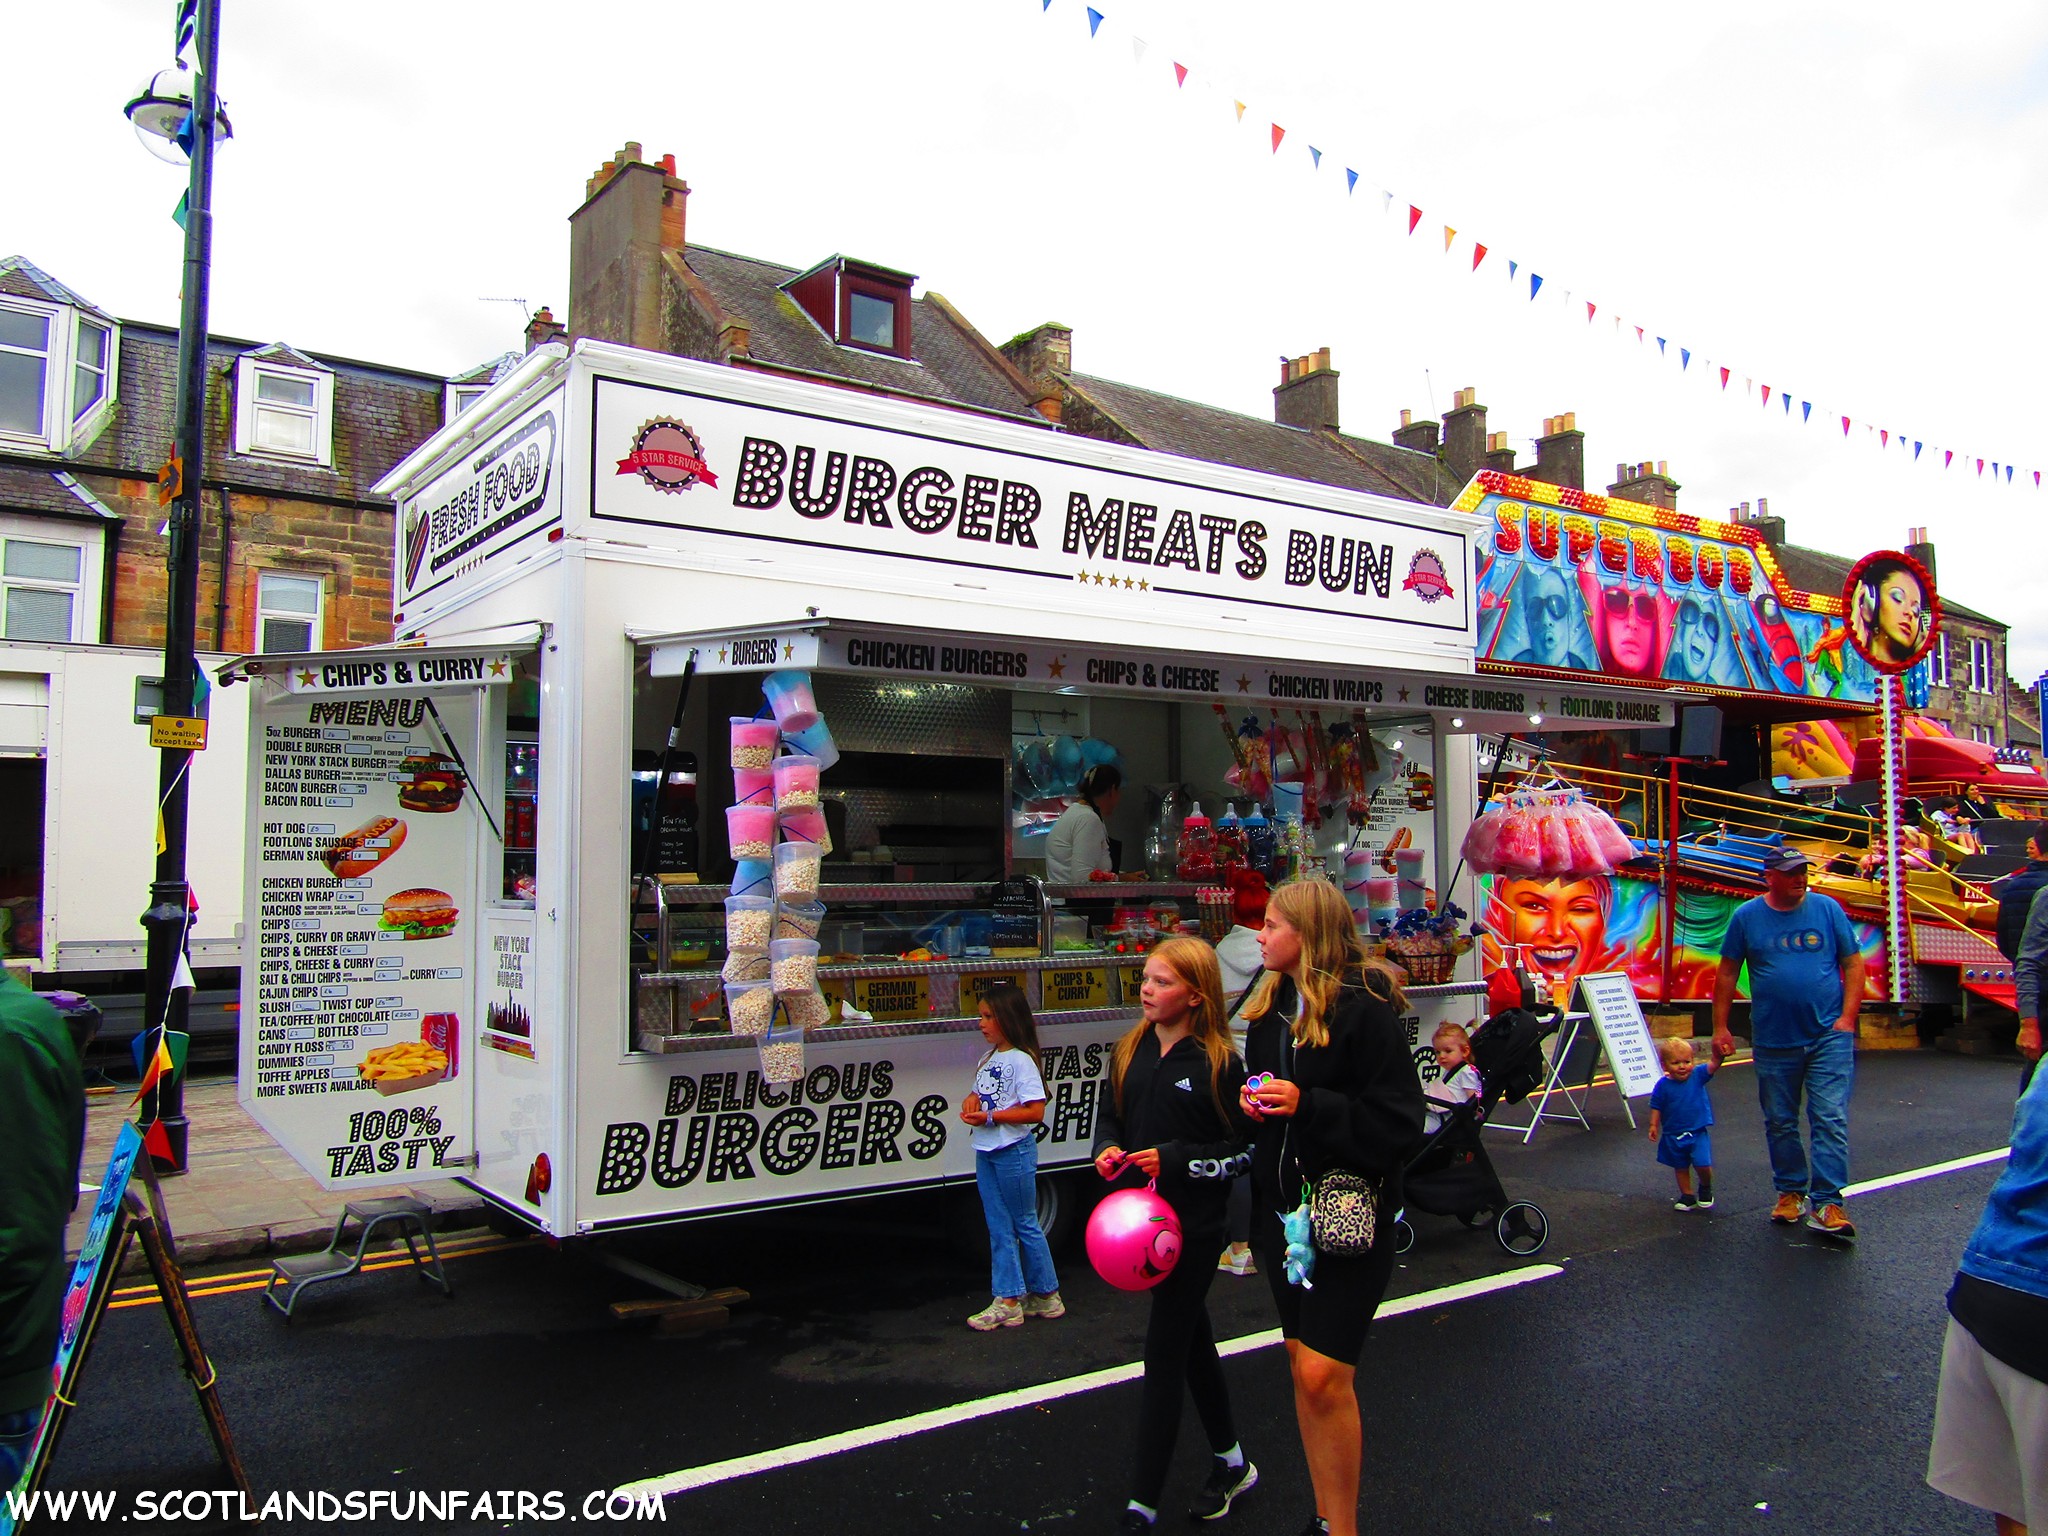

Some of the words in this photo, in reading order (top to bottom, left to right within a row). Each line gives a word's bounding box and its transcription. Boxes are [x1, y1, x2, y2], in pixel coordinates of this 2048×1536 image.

[632, 453, 639, 464] 5
[641, 452, 665, 463] STAR
[667, 454, 704, 473] SERVICE
[430, 480, 480, 553] FRESH
[483, 442, 540, 520] FOOD
[732, 435, 1042, 549] BURGER
[1062, 491, 1268, 581] MEATS
[1284, 528, 1394, 599] BUN
[731, 638, 777, 666] BURGERS
[847, 638, 934, 672] CHICKEN
[940, 645, 1028, 678] BURGERS
[323, 662, 388, 688] CHIPS
[393, 660, 413, 684] &
[418, 657, 486, 683] CURRY
[1087, 658, 1138, 686] CHIPS
[1141, 662, 1157, 688] &
[1161, 664, 1220, 693] CHEESE
[1268, 673, 1330, 699] CHICKEN
[1333, 678, 1383, 703] WRAPS
[1424, 684, 1469, 709] CHEESE
[1471, 688, 1525, 713] BURGERS
[309, 699, 428, 728] MENU
[1560, 696, 1614, 719] FOOTLONG
[1616, 700, 1661, 723] SAUSAGE
[172, 730, 201, 739] waiting
[266, 726, 281, 737] 5oz
[283, 726, 321, 739] BURGER
[154, 739, 182, 747] except
[266, 740, 302, 753] DOUBLE
[305, 742, 342, 754] BURGER
[265, 754, 288, 766] NEW
[291, 755, 316, 767] YORK
[319, 756, 349, 768] STACK
[351, 757, 388, 769] BURGER
[265, 767, 302, 779] DALLAS
[304, 769, 341, 781] BURGER
[265, 781, 298, 793] BACON
[300, 782, 338, 794] BURGER
[264, 795, 298, 806] BACON
[300, 796, 323, 807] ROLL
[264, 823, 283, 834] HOT
[286, 823, 306, 834] DOG
[263, 837, 312, 848] FOOTLONG
[315, 837, 358, 848] SAUSAGE
[263, 850, 304, 861] GERMAN
[262, 878, 303, 889] CHICKEN
[306, 878, 343, 888] BURGER
[262, 891, 303, 902] CHICKEN
[306, 892, 334, 902] WRAP
[261, 904, 302, 916] NACHOS
[261, 919, 290, 930] CHIPS
[261, 932, 293, 944] CHIPS,
[296, 932, 327, 943] CURRY
[330, 932, 344, 942] OR
[346, 931, 376, 942] GRAVY
[494, 936, 510, 952] NEW
[511, 936, 530, 953] YORK
[261, 946, 291, 957] CHIPS
[292, 946, 300, 956] &
[304, 945, 338, 956] CHEESE
[260, 960, 292, 972] CHIPS,
[295, 960, 330, 970] CHEESE
[333, 959, 341, 969] &
[344, 958, 374, 969] CURRY
[500, 954, 522, 971] STACK
[260, 974, 280, 985] SALT
[282, 974, 289, 984] &
[291, 973, 315, 984] CHILLI
[318, 972, 341, 983] CHIPS
[410, 969, 436, 980] CURRY
[497, 970, 524, 989] BURGER
[1054, 972, 1082, 986] CHIPS
[1086, 972, 1094, 985] &
[260, 987, 290, 999] CAJUN
[292, 987, 318, 998] CHIPS
[868, 981, 916, 996] GERMAN
[1058, 986, 1090, 1000] CURRY
[260, 1001, 291, 1013] SLUSH
[322, 999, 352, 1010] TWIST
[355, 998, 374, 1009] CUP
[868, 996, 918, 1012] SAUSAGE
[260, 1012, 340, 1027] TEA/COFFEE/HOT
[341, 1011, 390, 1023] CHOCOLATE
[259, 1028, 286, 1041] CANS
[318, 1026, 359, 1037] BOTTLES
[259, 1043, 291, 1055] CANDY
[294, 1042, 324, 1053] FLOSS
[258, 1057, 304, 1069] DUMMIES
[1040, 1042, 1114, 1081] TAS
[258, 1072, 291, 1083] TOFFEE
[295, 1070, 330, 1081] APPLES
[257, 1086, 285, 1097] MORE
[288, 1083, 327, 1095] SWEETS
[330, 1079, 377, 1092] AVAILABLE
[664, 1060, 894, 1116] DELICIOUS
[349, 1106, 442, 1142] 100%
[596, 1094, 950, 1196] BURGERS
[326, 1136, 456, 1178] TASTY
